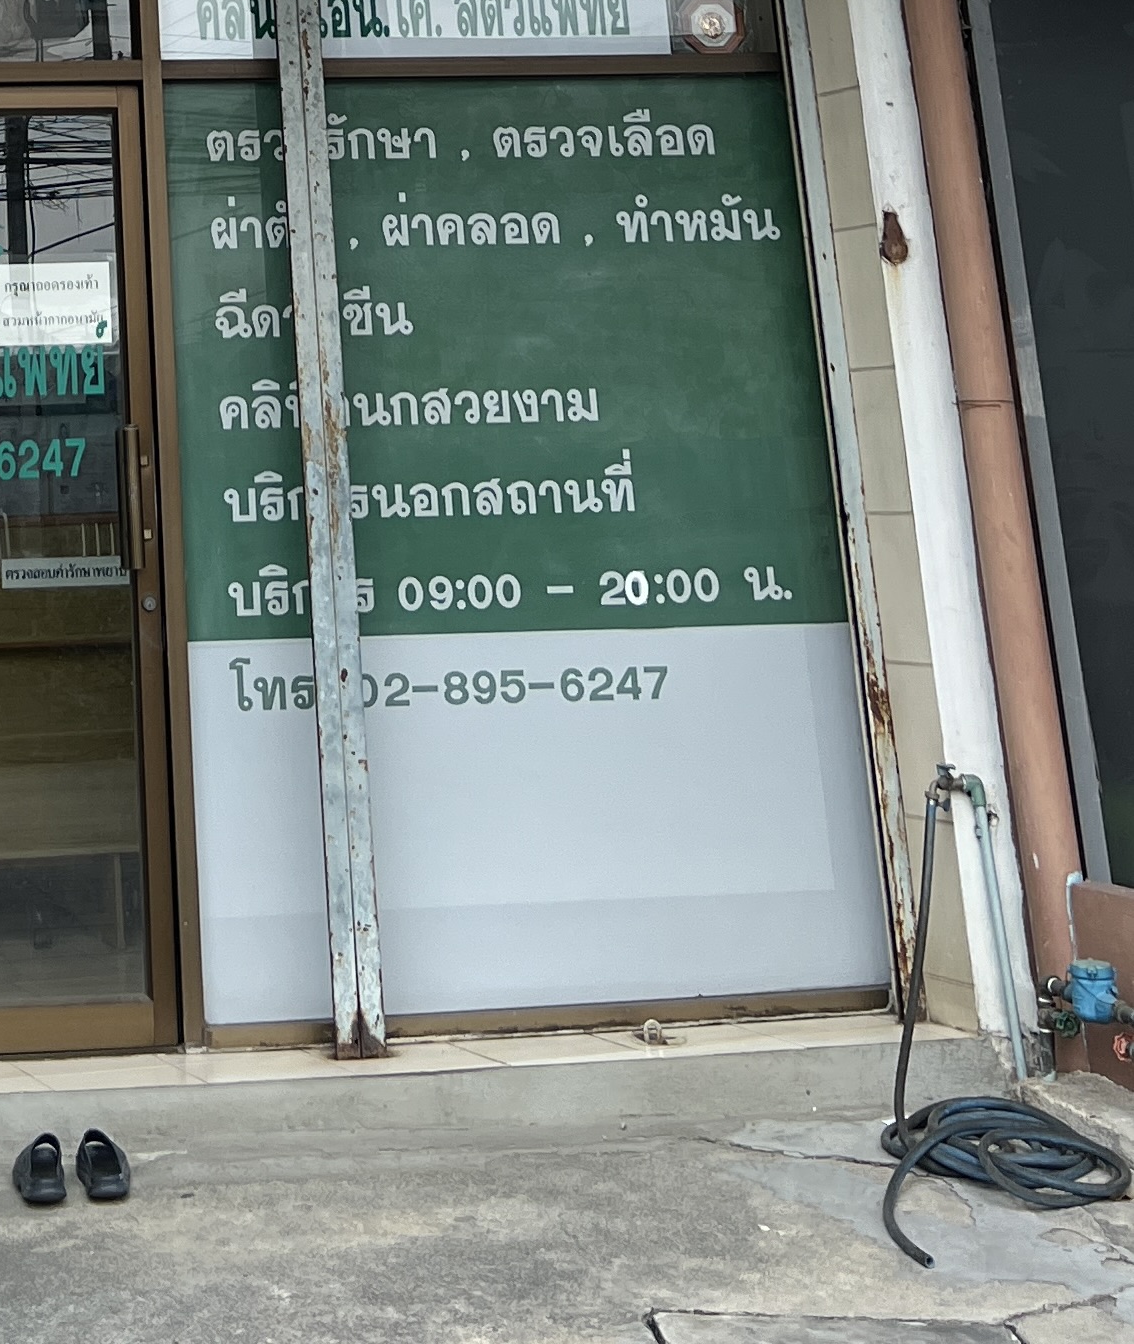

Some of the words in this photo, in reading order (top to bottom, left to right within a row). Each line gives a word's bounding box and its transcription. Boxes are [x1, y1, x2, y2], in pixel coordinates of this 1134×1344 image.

[206, 113, 437, 162] ตรวรักษา
[493, 108, 716, 160] ตรวจเลือด
[382, 192, 561, 247] ผ่าคลอด
[616, 193, 781, 244] ทำหมัน
[4, 273, 100, 297] กรุณาถอดรองเท้า
[216, 285, 414, 339] ฉีดซีน
[219, 378, 599, 430] คลินกสวยงาม
[223, 449, 636, 523] บริกรนอกสถานที่
[228, 564, 375, 616] บริกร
[398, 574, 522, 611] 09:00
[600, 568, 720, 608] 20:00
[744, 565, 794, 601] น.
[362, 665, 669, 708] 02-895-6247
